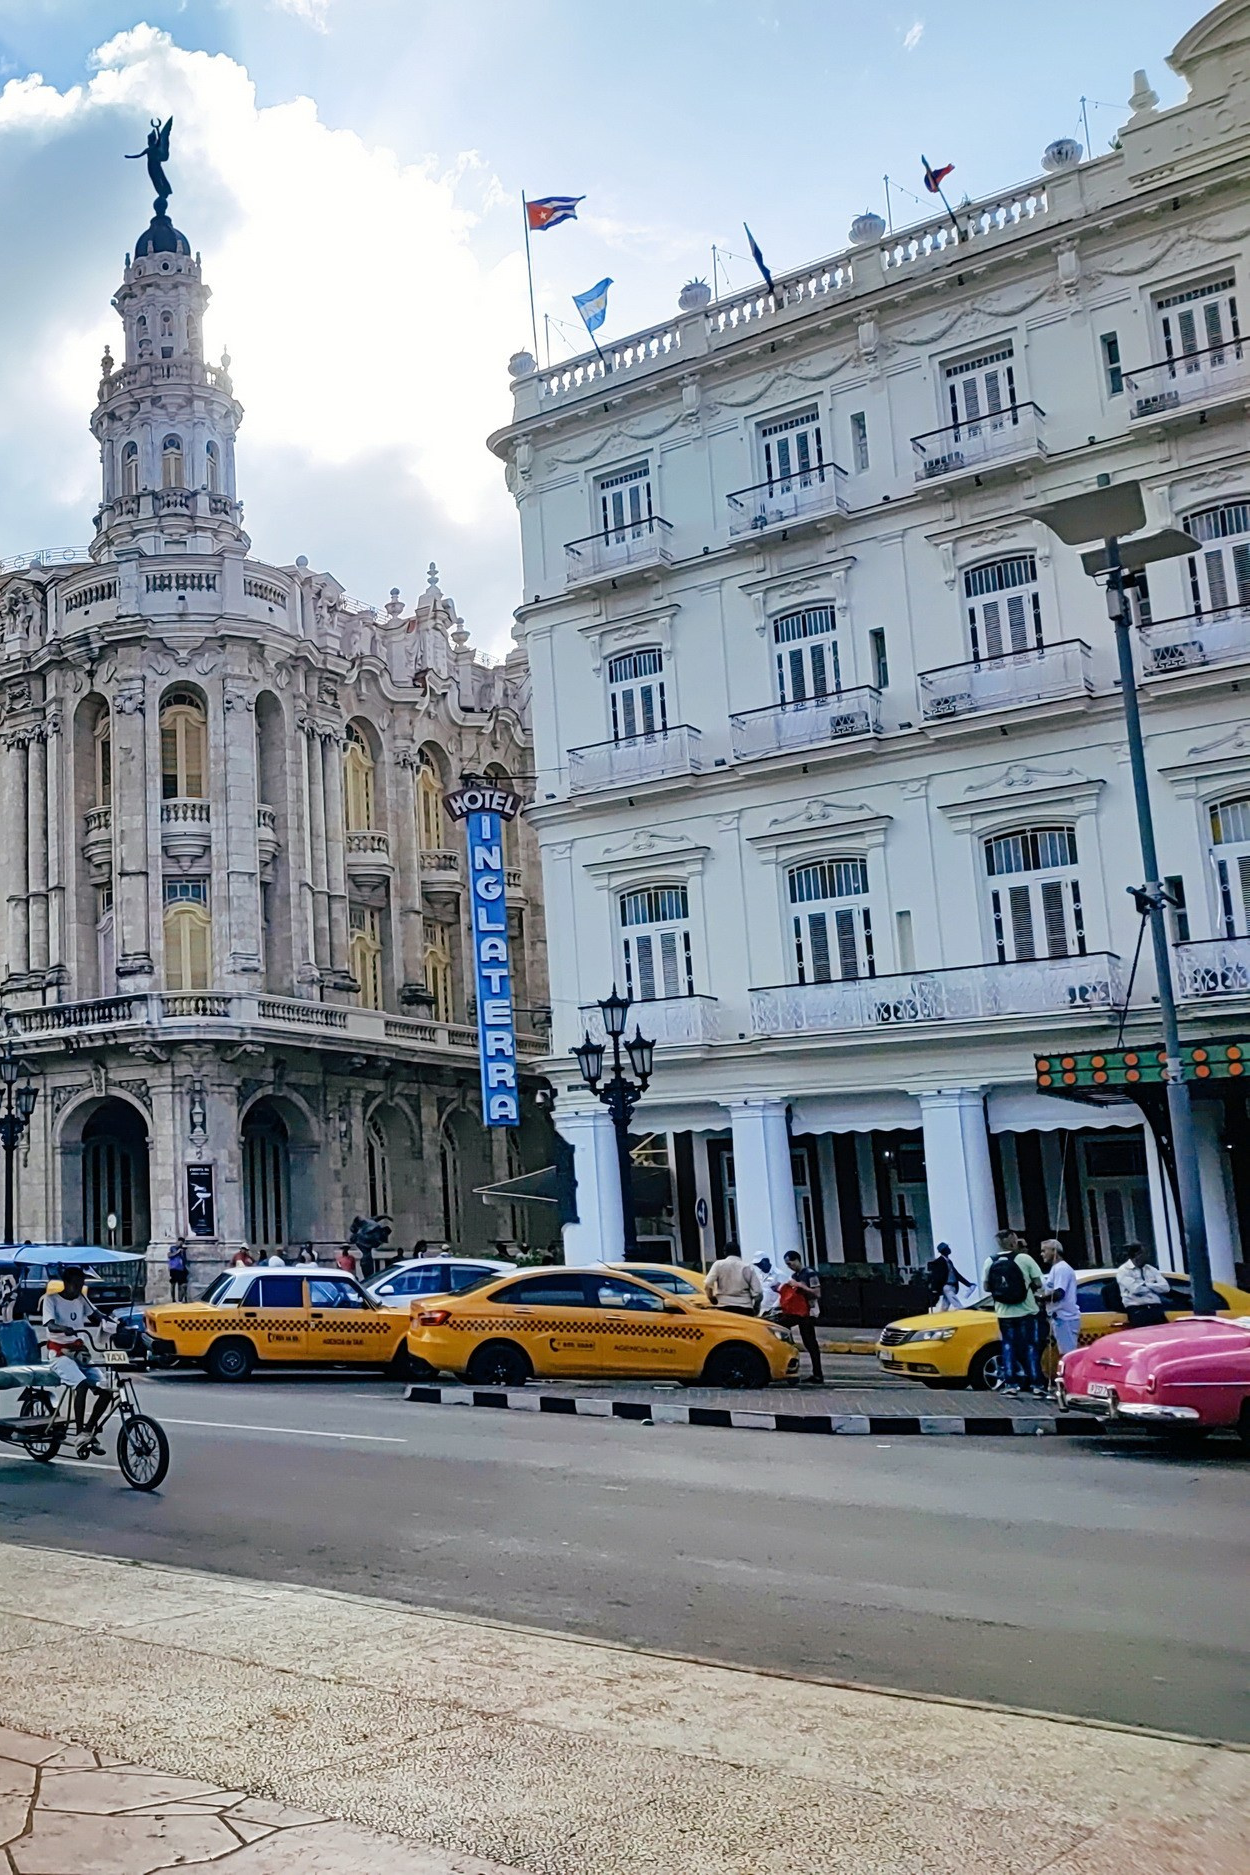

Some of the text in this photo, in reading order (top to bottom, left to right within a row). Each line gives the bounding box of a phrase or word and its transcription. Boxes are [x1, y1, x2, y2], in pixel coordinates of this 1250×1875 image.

[448, 789, 516, 816] HOTEL
[474, 815, 517, 1120] INGLATERRA
[106, 1352, 126, 1362] TAXI
[614, 1344, 649, 1353] AGENCIA
